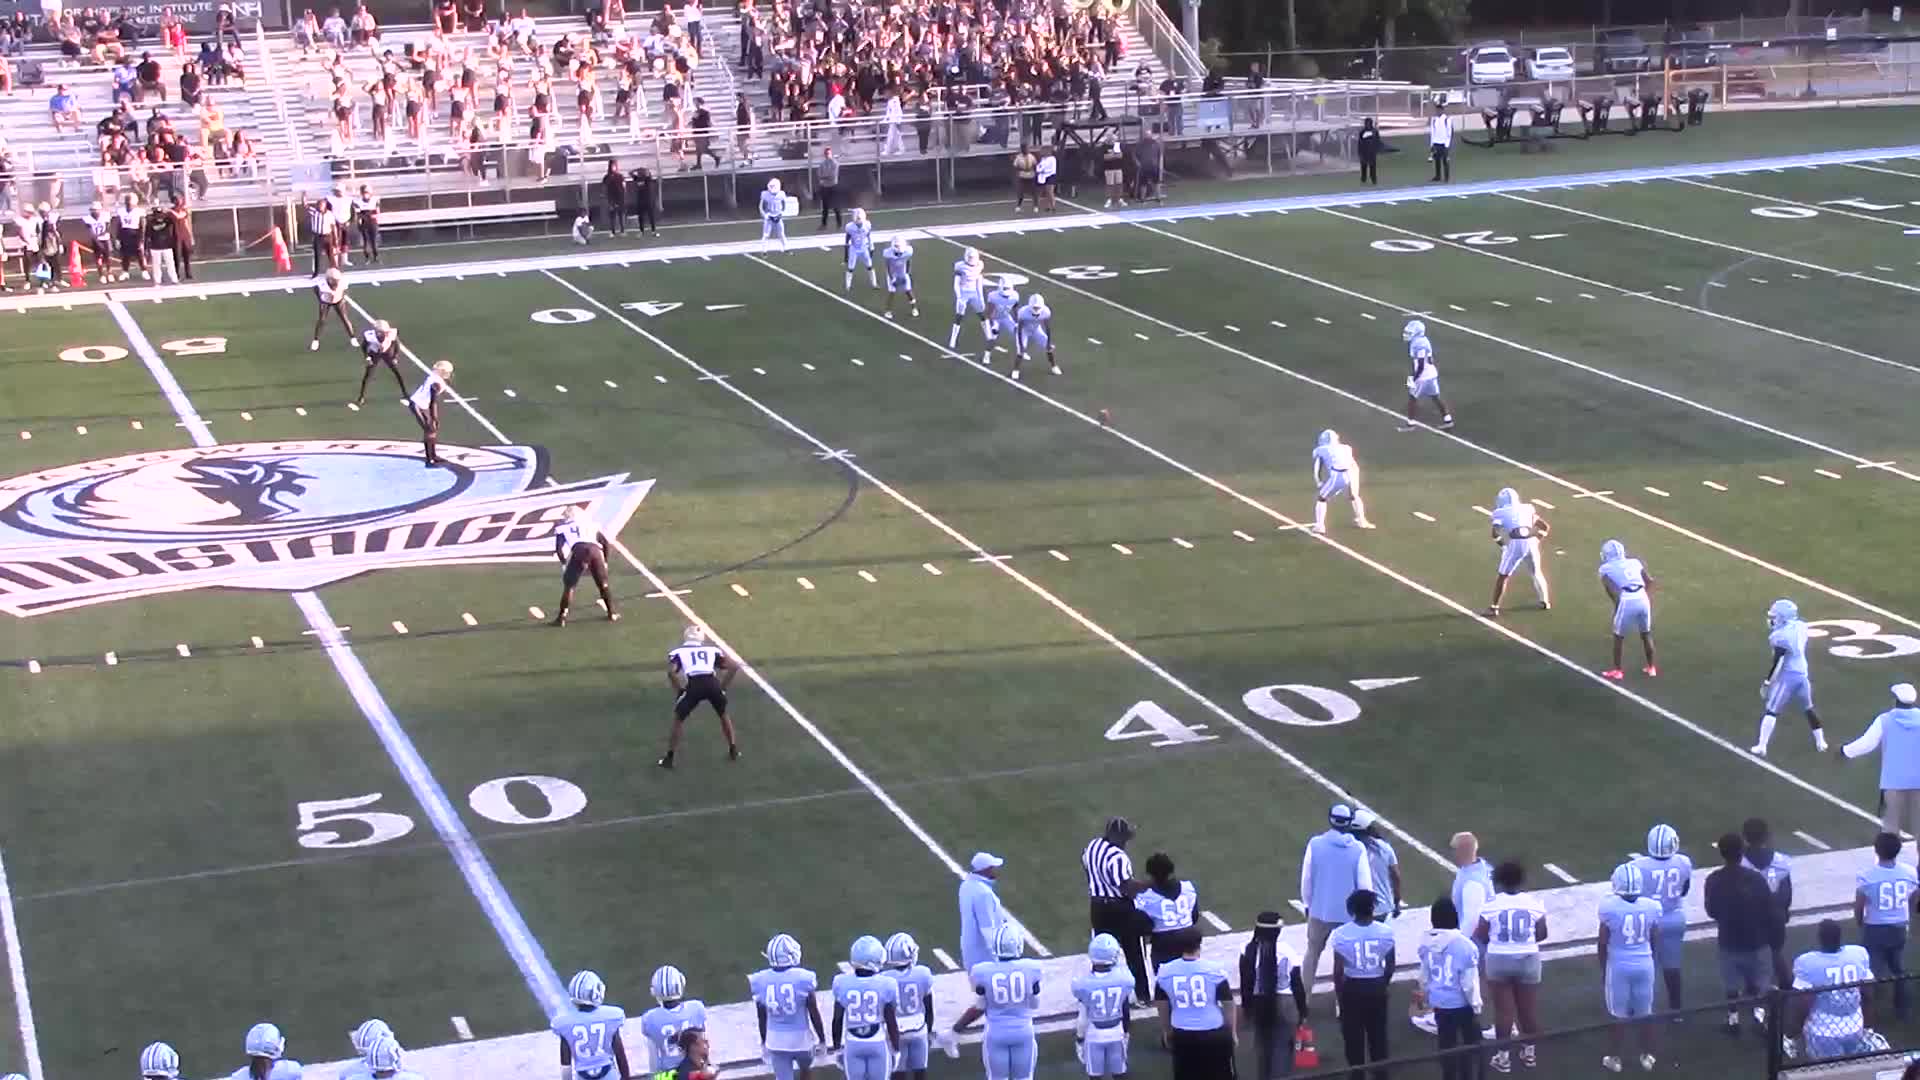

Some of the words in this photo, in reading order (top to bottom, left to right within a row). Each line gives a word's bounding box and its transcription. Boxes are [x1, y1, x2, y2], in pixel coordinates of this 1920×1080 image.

[134, 14, 196, 25] MEDINE
[149, 2, 213, 14] INTITUTE
[568, 525, 581, 539] 4
[691, 650, 708, 666] 19
[1104, 684, 1361, 747] 40
[298, 776, 587, 848] 50
[1651, 868, 1680, 899] 72
[1498, 909, 1531, 942] 10
[1622, 913, 1646, 944] 41
[1354, 940, 1379, 970] 15
[766, 983, 797, 1015] 43
[991, 970, 1026, 1004] 60
[1091, 987, 1123, 1018] 37
[1172, 975, 1208, 1008] 58
[847, 990, 879, 1022] 23
[572, 1022, 606, 1057] 27
[661, 1020, 689, 1057] 2
